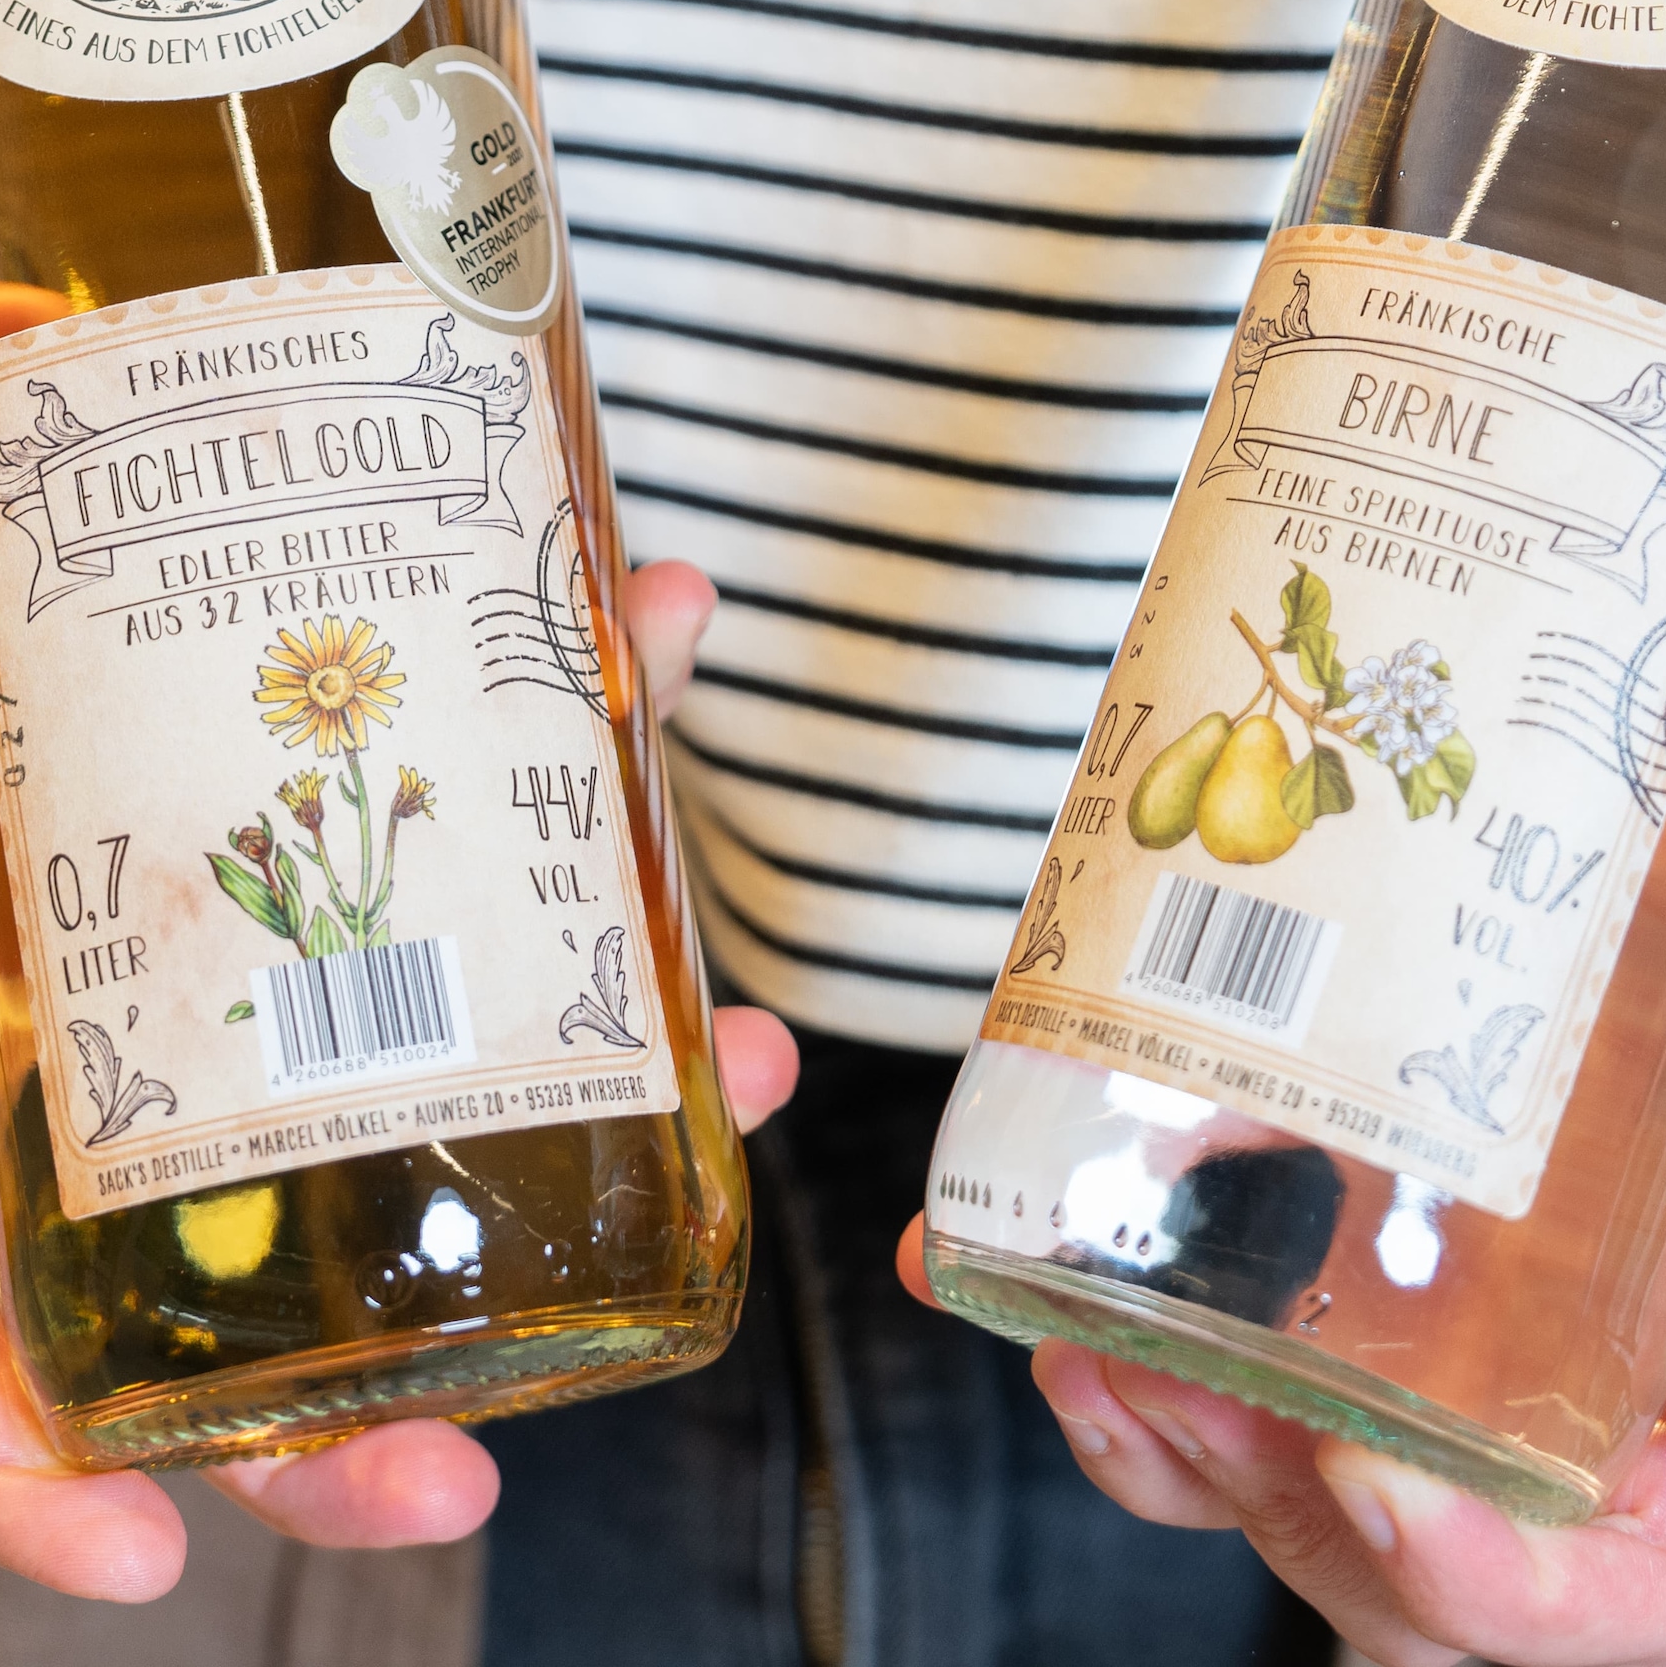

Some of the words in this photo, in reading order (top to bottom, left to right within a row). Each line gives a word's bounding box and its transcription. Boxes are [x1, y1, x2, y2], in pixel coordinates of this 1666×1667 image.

[82, 32, 137, 64] AUS
[147, 37, 208, 65] DEM
[471, 121, 516, 165] GOLD
[440, 170, 541, 253] FRANKFURT
[455, 206, 546, 275] INTERNATIONAL
[466, 249, 522, 296] TROPHY
[127, 329, 370, 397] FRÄNKISCHES
[1359, 286, 1567, 366] FRÄNKISCHE
[1339, 373, 1515, 467] BIRNE
[75, 413, 452, 527] FICHTELGOLD
[1257, 467, 1337, 511] FEINE
[1343, 484, 1539, 569] SPIRITUOSE
[160, 538, 267, 590] EDLER
[282, 522, 400, 565] BITTER
[1274, 515, 1330, 556] AUS
[1345, 534, 1476, 597] BIRNEN
[125, 602, 182, 647] AUS
[199, 591, 241, 630] 32
[263, 563, 452, 617] KRÄUTERN
[1086, 703, 1154, 783] 0,7
[1062, 795, 1116, 836] LITER
[46, 834, 131, 932] 0,7
[529, 864, 600, 906] VOL.
[61, 935, 150, 996] LITER
[1453, 903, 1529, 973] VOL.
[295, 1057, 367, 1083] 260688
[379, 1043, 450, 1067] 510024
[1020, 1003, 1068, 1034] DESTILLE
[1077, 1016, 1134, 1053] MARCEL
[1136, 1032, 1195, 1072] VÖLKEL
[1210, 1057, 1279, 1100] AUWEG
[1280, 1081, 1305, 1109] 20
[1325, 1097, 1384, 1139] 95339
[97, 1158, 148, 1198] SACK'S
[152, 1143, 226, 1187] DESTILLE
[248, 1125, 319, 1160] MARCEL
[321, 1108, 392, 1147] VÖLKEL
[414, 1097, 480, 1130] AUWEG
[483, 1090, 506, 1117] 20
[525, 1081, 575, 1114] 95339
[576, 1073, 647, 1106] WIRSBERG
